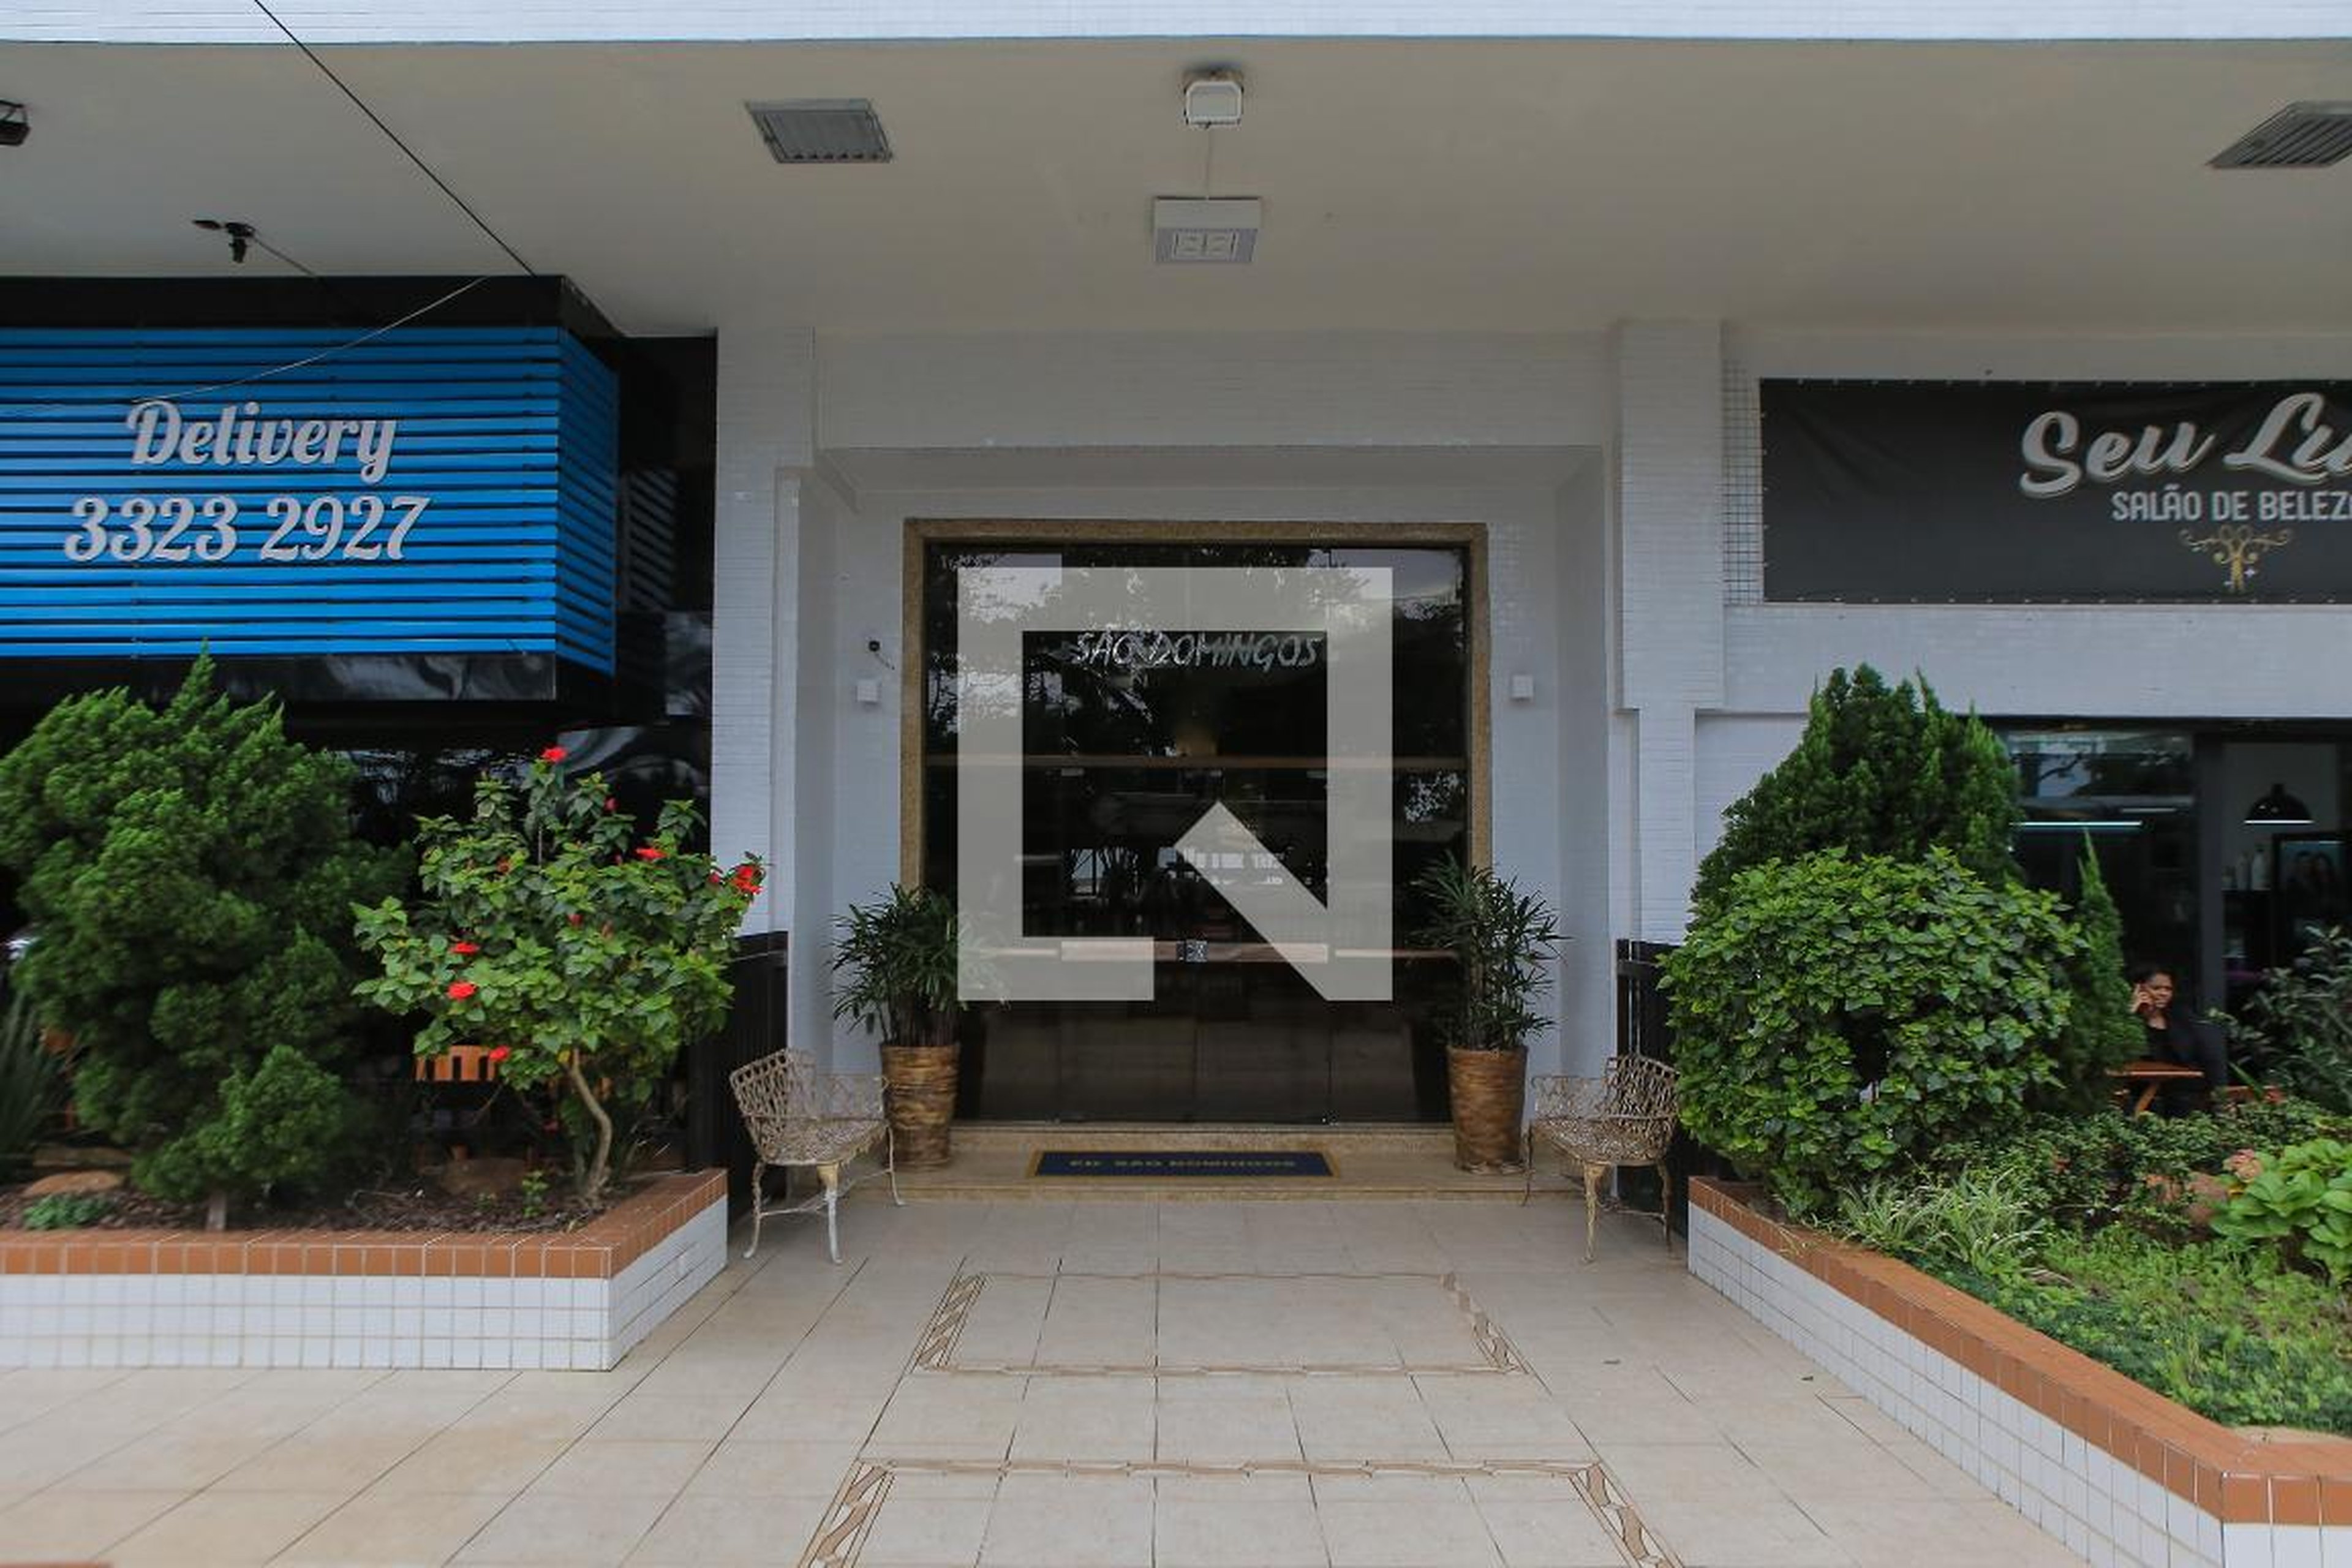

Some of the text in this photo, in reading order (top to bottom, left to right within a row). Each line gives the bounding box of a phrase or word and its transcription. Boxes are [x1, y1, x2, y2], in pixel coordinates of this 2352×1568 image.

[127, 400, 397, 483] Delivery
[2021, 410, 2216, 499] Seu
[63, 495, 431, 561] 3323 2927
[2113, 483, 2352, 521] SALÃO DE BELEZ
[1144, 631, 1321, 672] DOMINGOS
